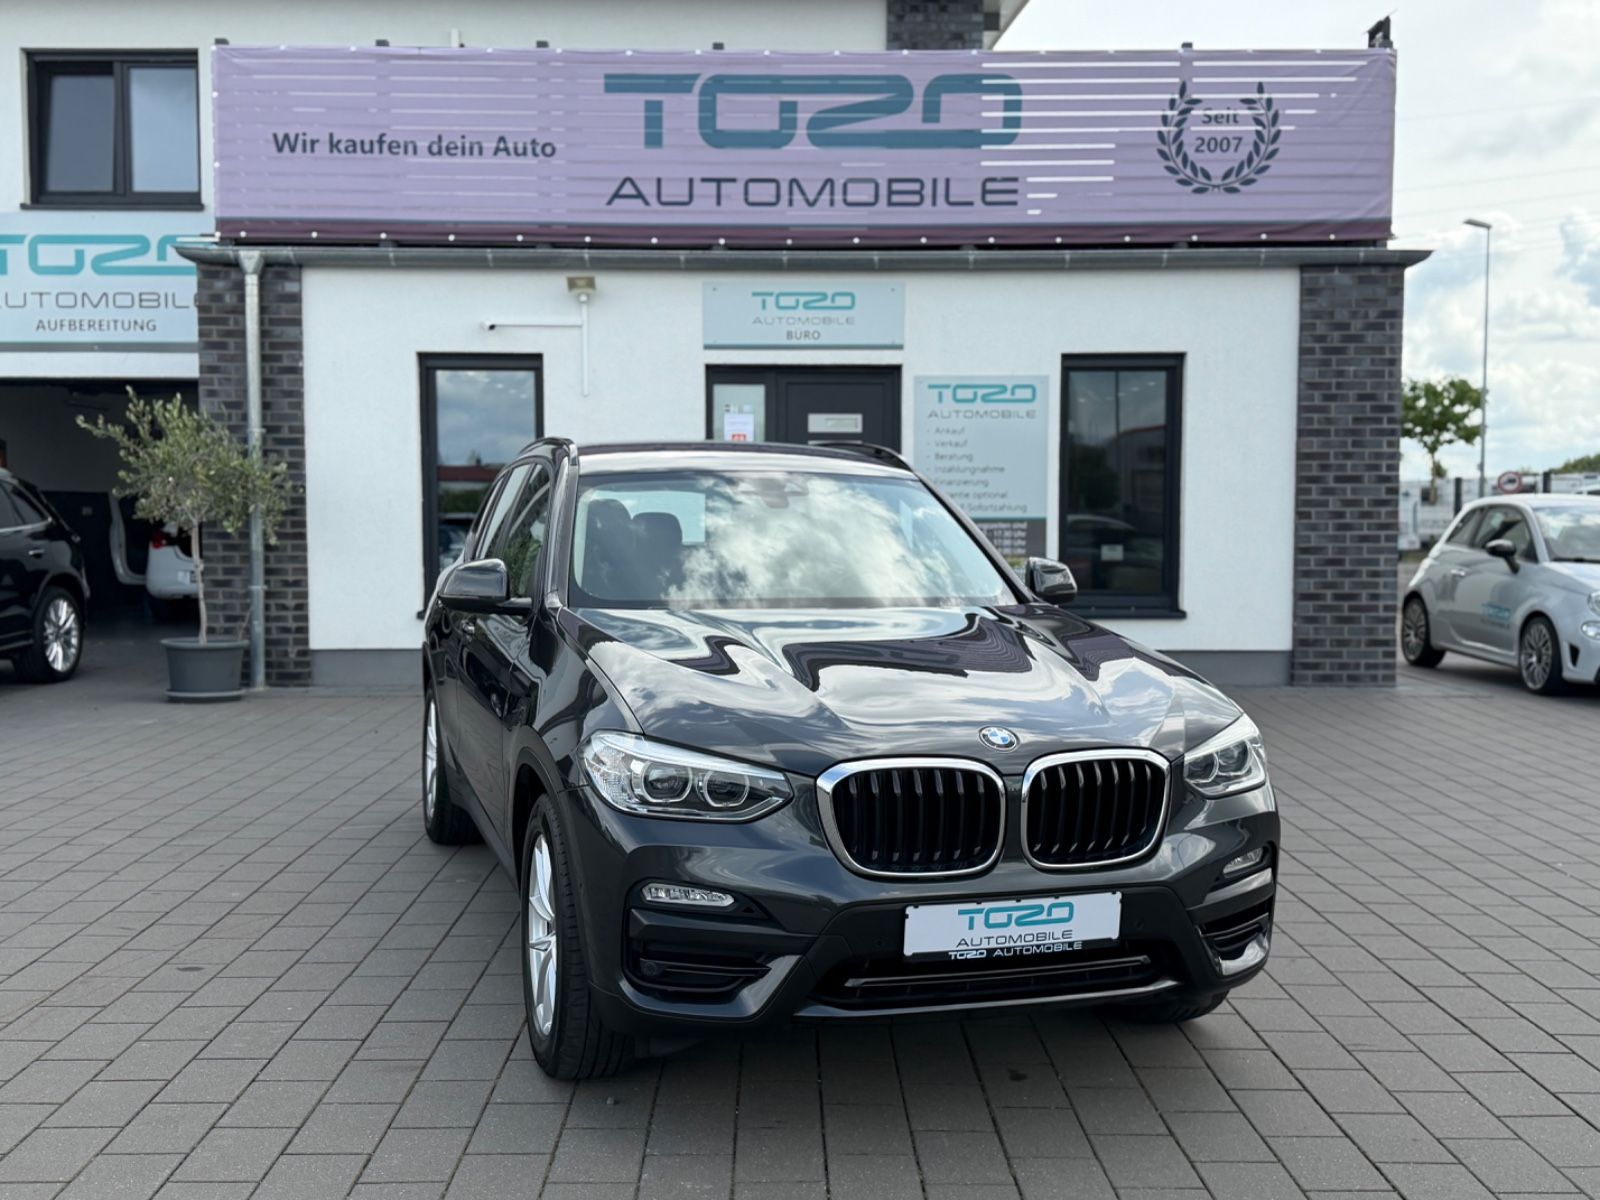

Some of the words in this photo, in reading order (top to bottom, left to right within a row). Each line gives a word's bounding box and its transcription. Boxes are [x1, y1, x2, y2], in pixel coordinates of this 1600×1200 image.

[604, 73, 1023, 149] TOZO
[1201, 107, 1240, 124] Seit
[272, 132, 320, 154] Wir
[328, 132, 418, 156] kaufen
[427, 134, 484, 157] dein
[492, 135, 557, 158] Auto
[1194, 136, 1244, 153] 2007
[605, 176, 1020, 207] AUTOMOBILE
[0, 292, 198, 309] UTOMOBIL
[752, 292, 856, 310] TOZO
[36, 319, 157, 332] AUFBEREITUNG
[752, 316, 856, 326] AUTOMOBILE
[928, 409, 1037, 419] AUTOMOBILE
[958, 901, 1074, 930] TOZO
[956, 929, 1073, 948] AUTOMOBILE
[948, 949, 987, 960] TOZO
[992, 941, 1083, 958] AUTOMOBILE
